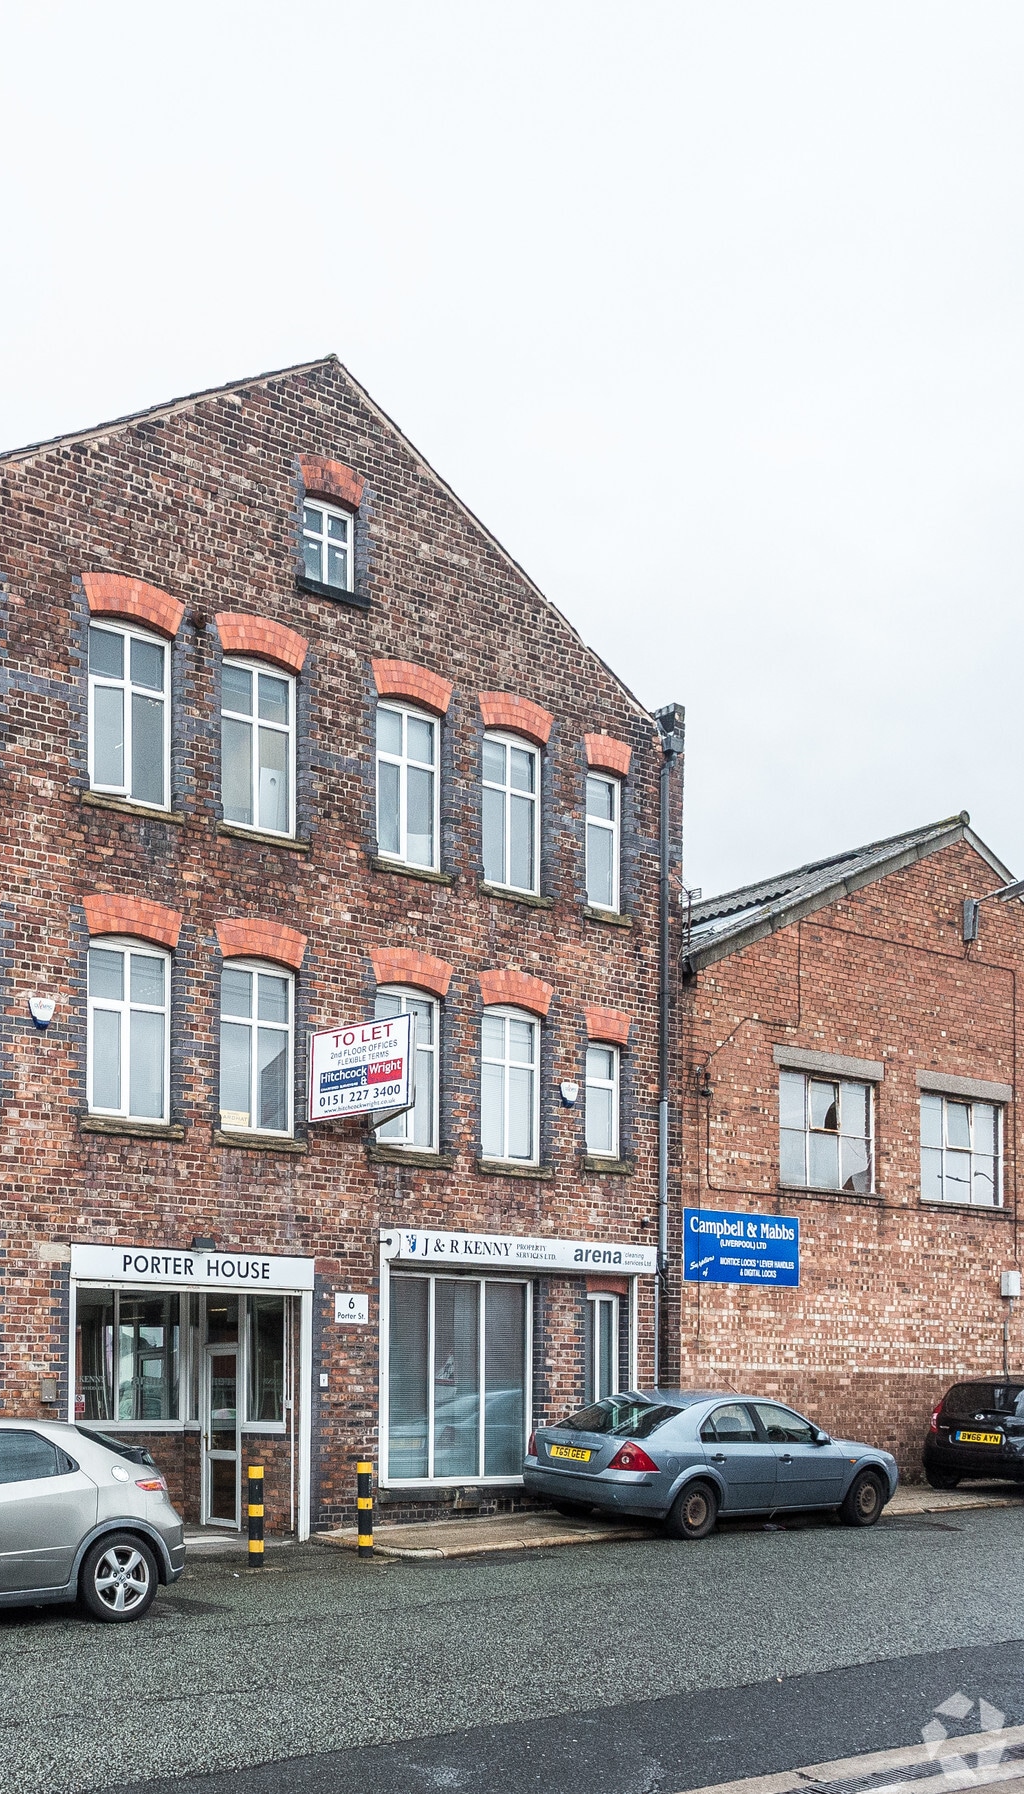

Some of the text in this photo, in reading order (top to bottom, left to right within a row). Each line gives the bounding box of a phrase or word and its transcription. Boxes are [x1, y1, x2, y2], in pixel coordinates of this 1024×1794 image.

[332, 1023, 393, 1048] TO LET
[344, 1046, 366, 1056] FLOOR
[368, 1039, 397, 1051] OFFICES
[338, 1051, 389, 1066] FLEXIBLE TERMS
[321, 1060, 401, 1085] Hitchcock & Wright
[320, 1085, 400, 1107] 0151 227 3400
[690, 1216, 794, 1240] Campbell & Mabbs
[421, 1237, 513, 1257] J & R KENNY
[516, 1243, 546, 1252] PROPERTY
[720, 1239, 767, 1250] (LIVERPOOL) LTD
[516, 1251, 543, 1260] SERVICES
[574, 1247, 622, 1265] arena
[625, 1252, 644, 1260] cleaning
[741, 1258, 756, 1267] LOCKS
[123, 1254, 270, 1280] PORTER HOUSE
[348, 1297, 355, 1309] 6
[571, 1449, 586, 1459] GEE
